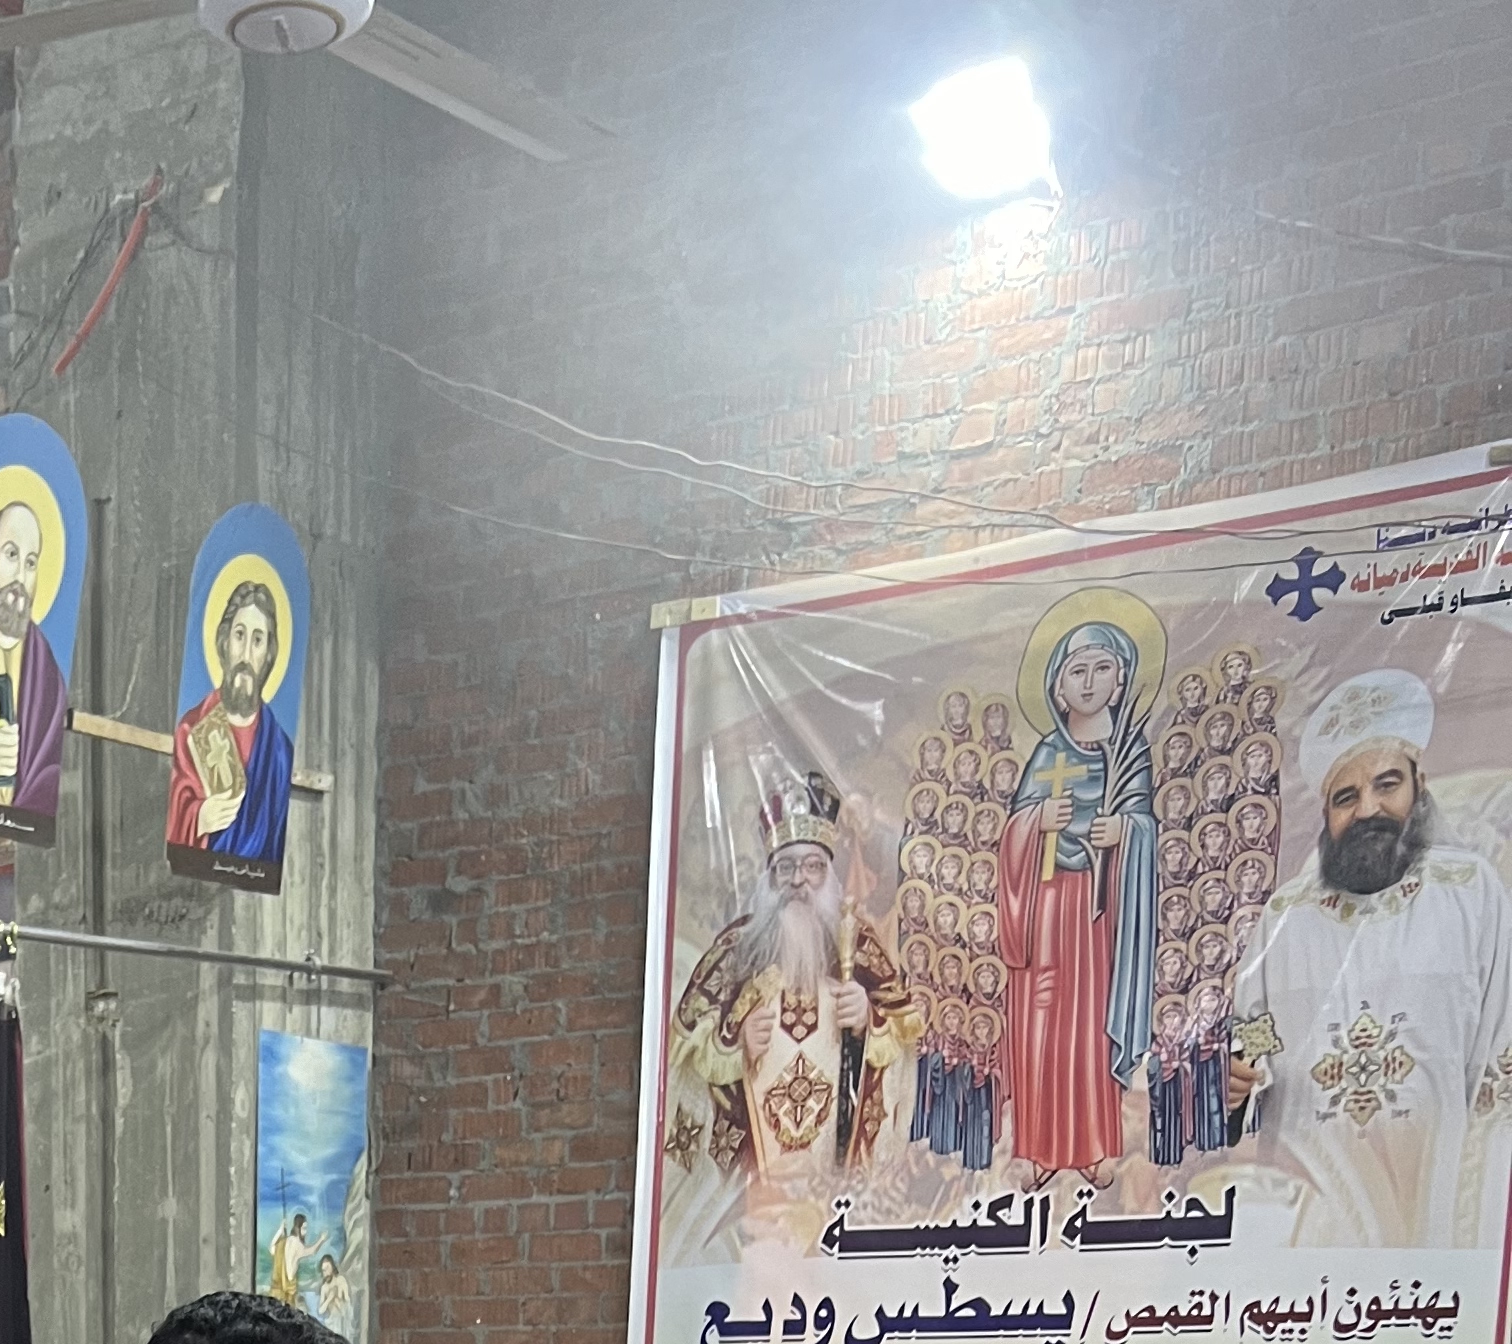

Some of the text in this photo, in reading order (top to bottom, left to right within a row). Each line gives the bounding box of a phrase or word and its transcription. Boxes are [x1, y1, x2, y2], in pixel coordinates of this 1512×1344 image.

[820, 1184, 1237, 1268] لجنة الكنيسة
[1239, 1274, 1330, 1344] أبيهم
[1332, 1278, 1461, 1340] يهنئون
